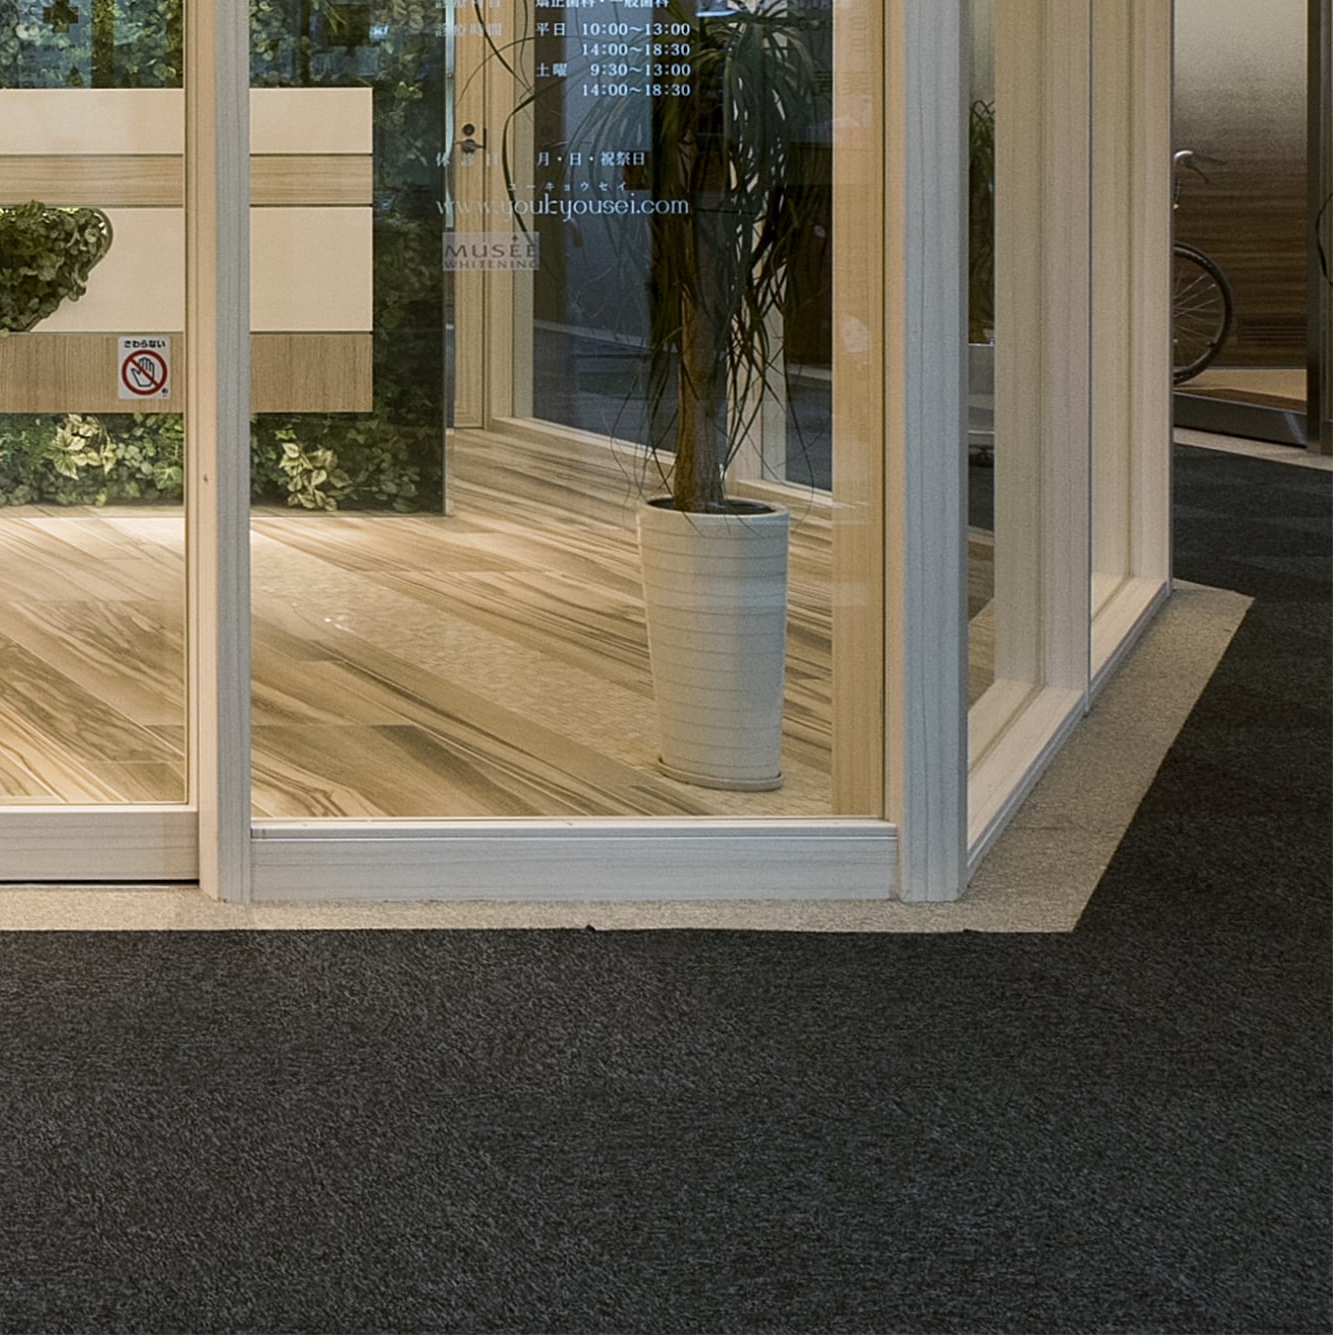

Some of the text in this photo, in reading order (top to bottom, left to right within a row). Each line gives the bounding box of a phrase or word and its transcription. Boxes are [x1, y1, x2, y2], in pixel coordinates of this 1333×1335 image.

[124, 339, 166, 349] さわらない
